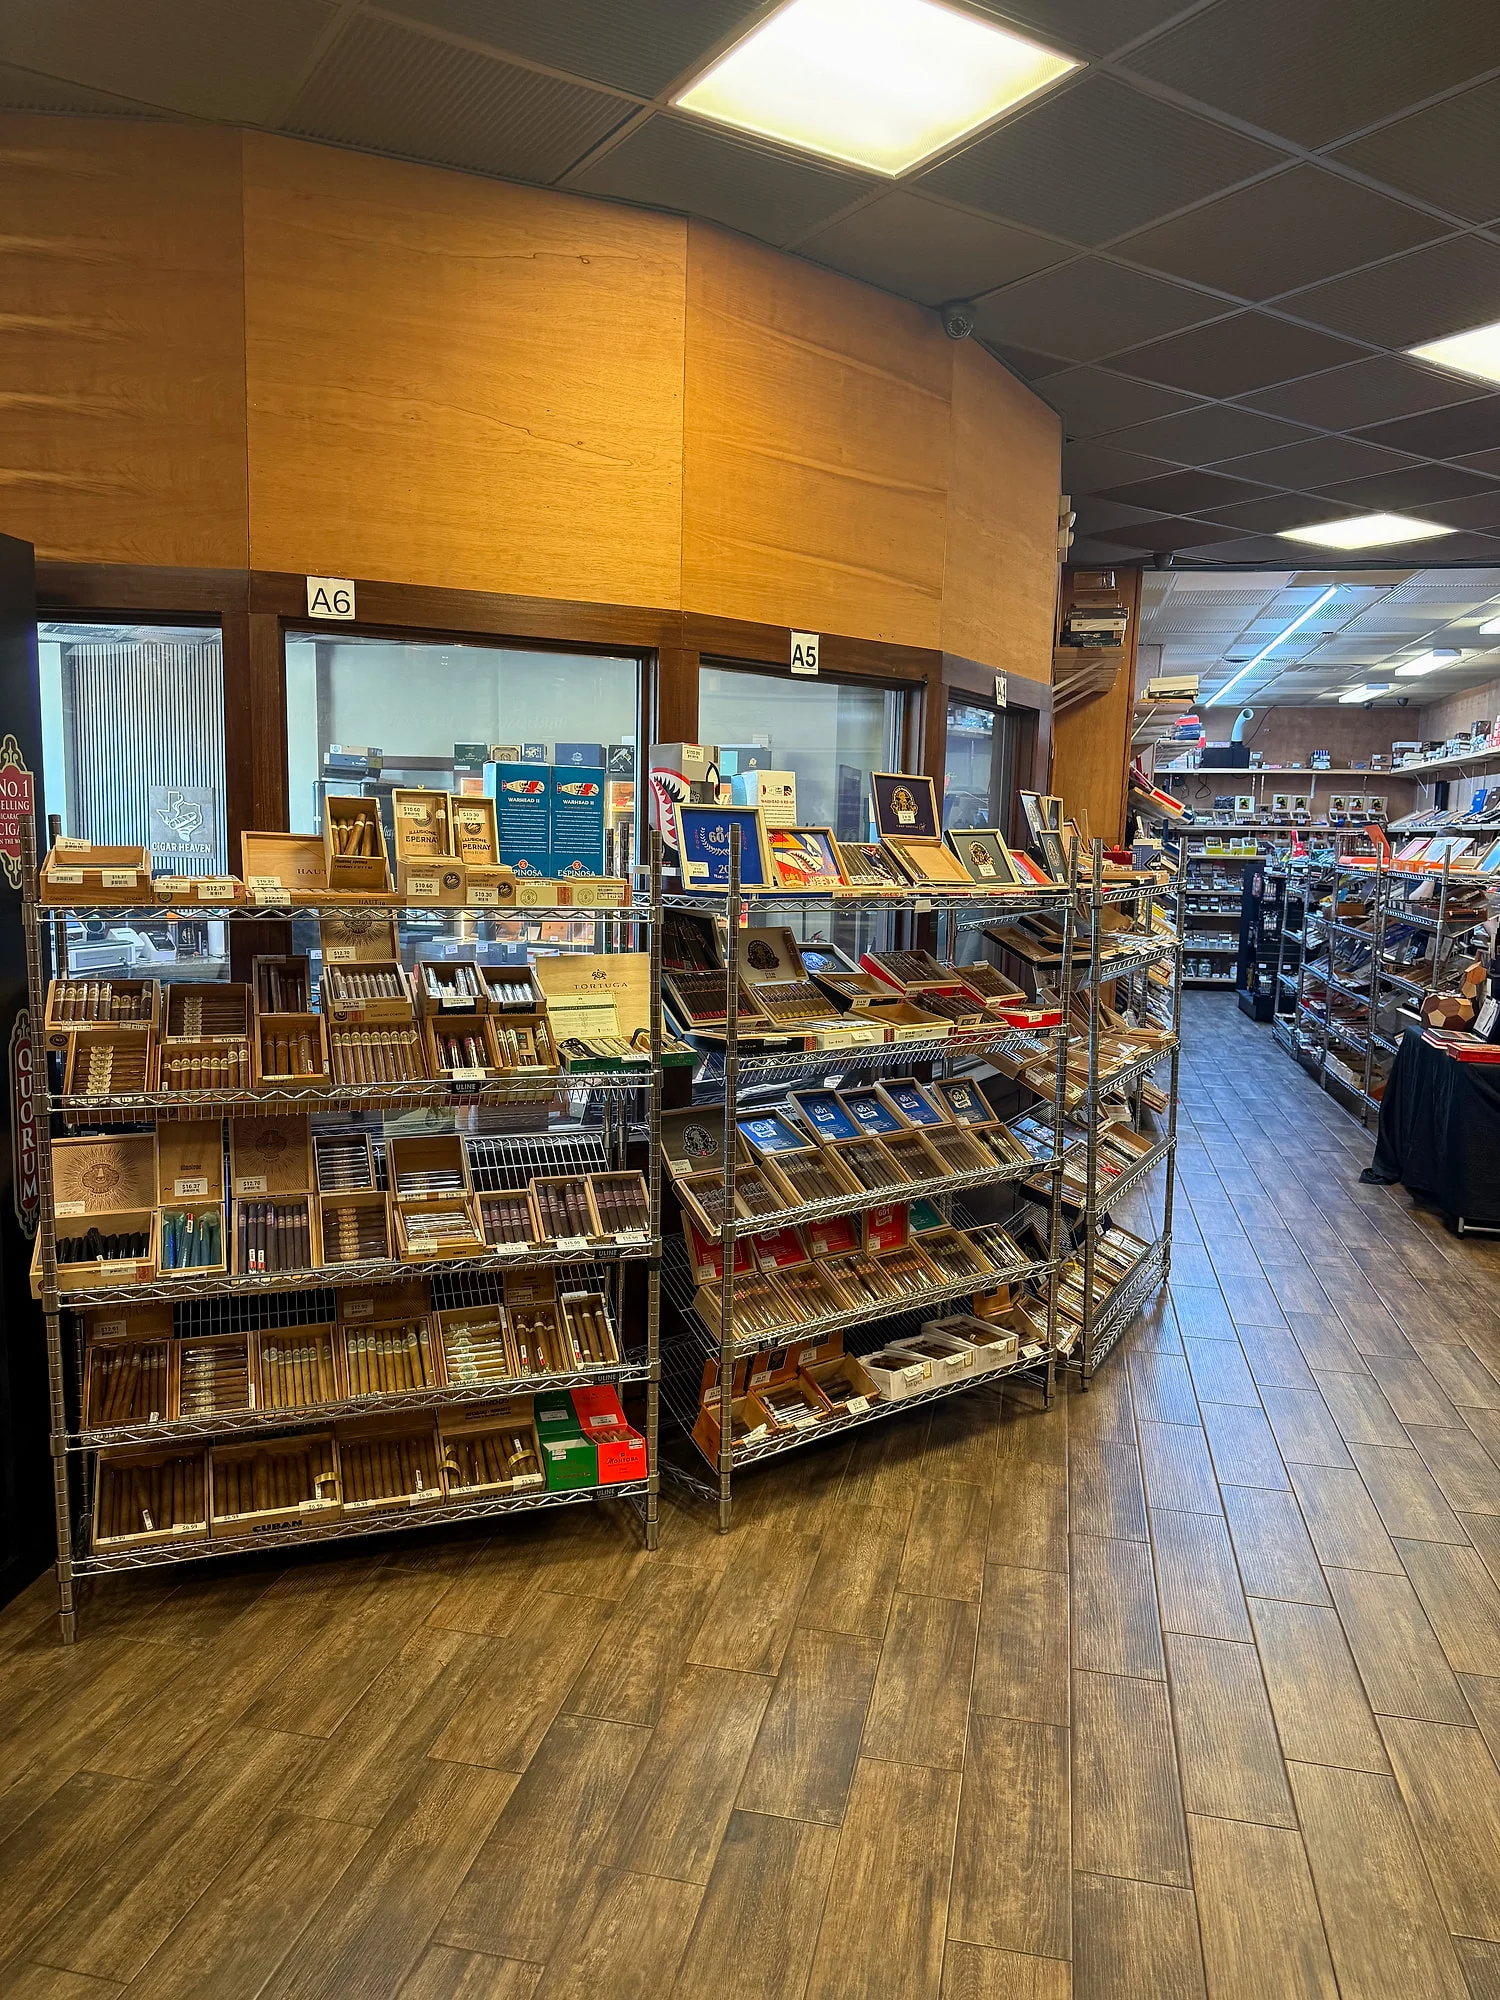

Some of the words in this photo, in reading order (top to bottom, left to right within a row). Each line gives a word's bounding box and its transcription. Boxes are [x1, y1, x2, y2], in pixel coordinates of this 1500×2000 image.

[310, 587, 351, 614] A6
[792, 643, 817, 667] A5
[0, 800, 30, 811] ELLING
[151, 842, 178, 851] CIGAR
[178, 842, 211, 853] HEAVEN
[462, 843, 492, 851] PERNAY
[513, 869, 543, 877] PINOSA
[557, 869, 596, 877] ESPINOSA
[573, 982, 628, 990] TORTUGA
[455, 1083, 476, 1091] ULINE
[18, 1048, 39, 1201] QUORUM
[878, 1208, 890, 1217] 601
[597, 1374, 617, 1382] ULINE
[596, 1488, 615, 1497] ULINE
[252, 1519, 303, 1533] CUBAN
